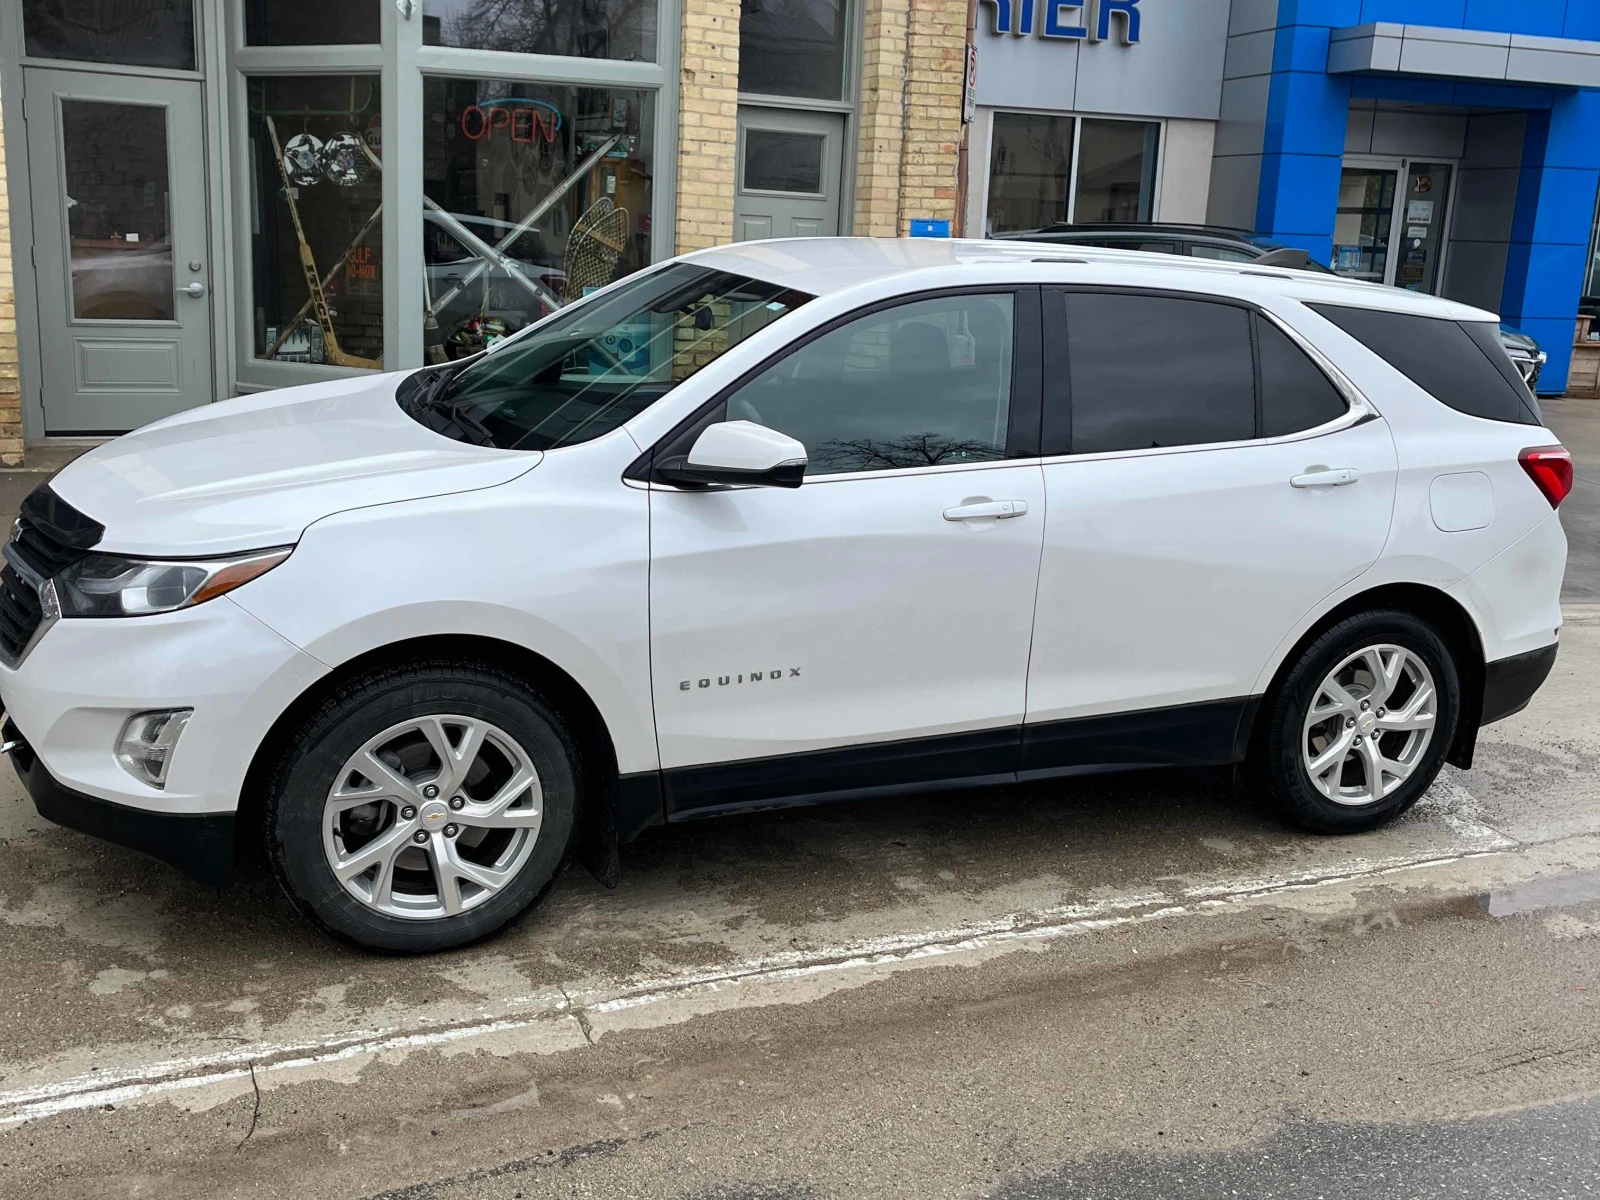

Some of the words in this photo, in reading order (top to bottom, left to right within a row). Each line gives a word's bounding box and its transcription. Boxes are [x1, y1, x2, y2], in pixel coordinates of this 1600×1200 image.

[462, 105, 556, 143] OPEN
[348, 246, 372, 264] GULF
[679, 667, 801, 691] EQUINOX
